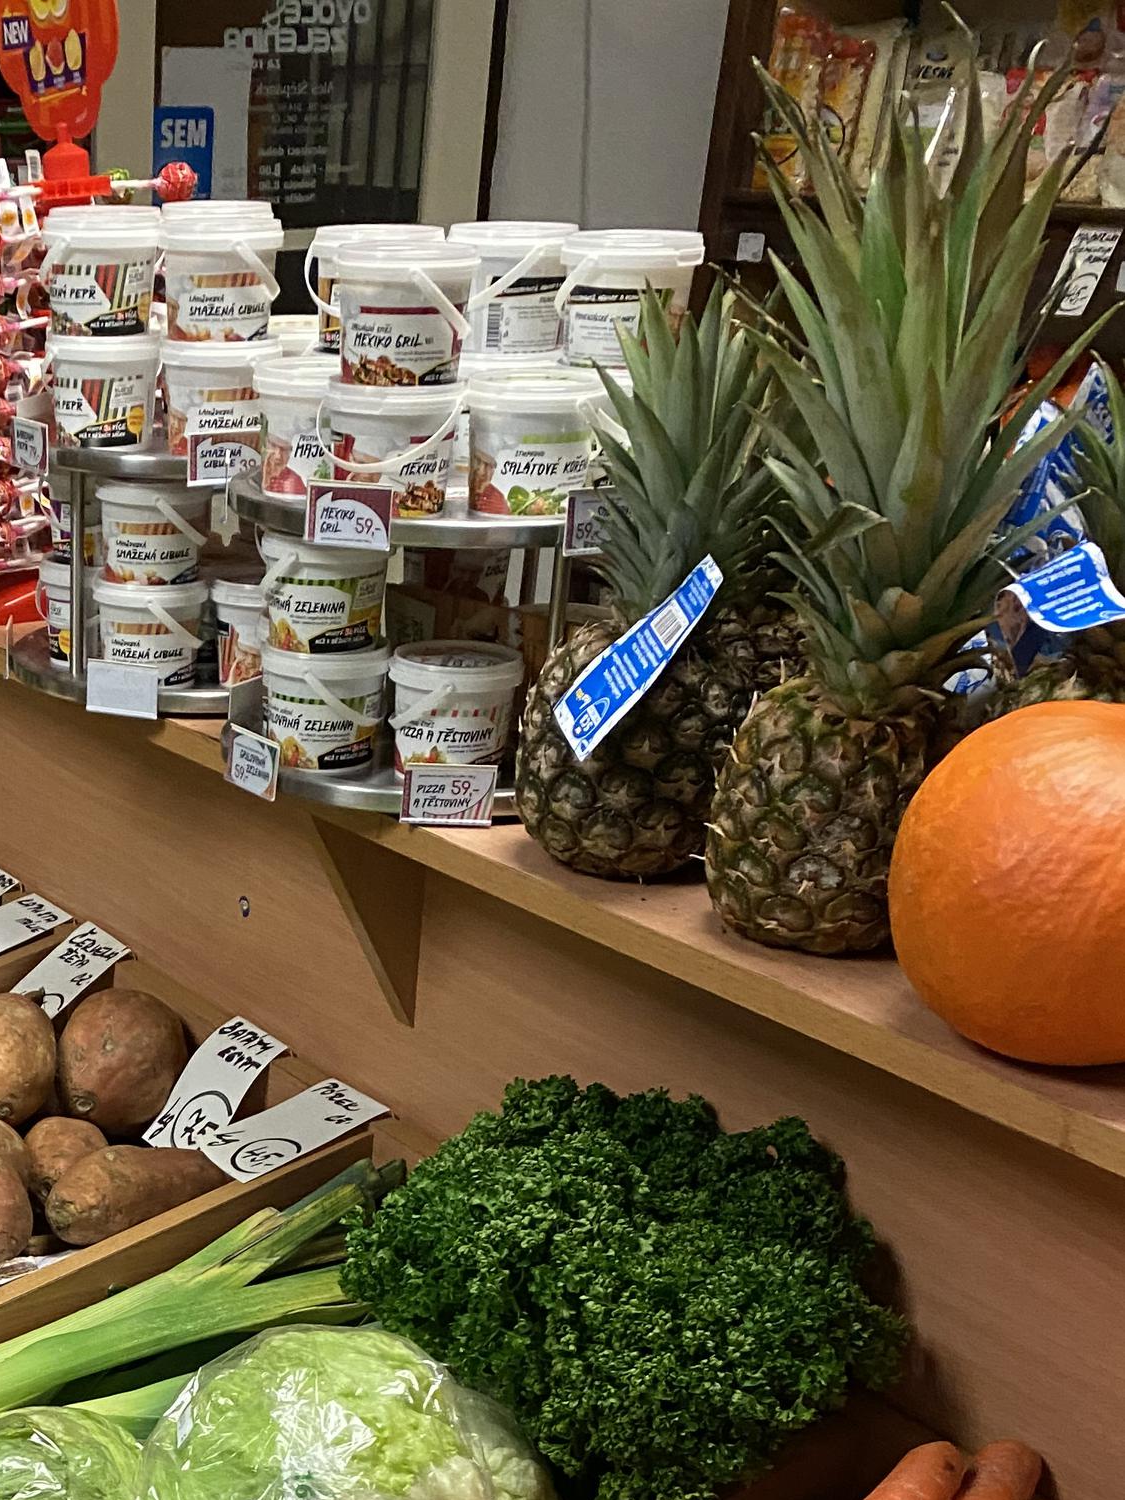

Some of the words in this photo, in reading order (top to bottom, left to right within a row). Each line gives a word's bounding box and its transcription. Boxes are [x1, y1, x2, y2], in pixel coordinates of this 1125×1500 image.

[2, 19, 29, 46] NEW
[160, 118, 207, 149] SEM
[70, 285, 96, 300] PEPŘ
[189, 302, 235, 317] SMAŽENÁ
[238, 302, 266, 315] CIBULE
[354, 332, 392, 348] MEXIKO
[395, 333, 423, 348] GRIL
[198, 416, 244, 429] SMAŽENÁ
[200, 445, 242, 459] SMAŽNÁ
[400, 460, 437, 477] MEXIKO
[501, 456, 562, 476] SALÁTOVÉ
[320, 507, 356, 520] MEXIKO
[320, 521, 342, 533] GRIL
[116, 548, 157, 560] SMAŽENÁ
[160, 547, 190, 560] CIBULE
[294, 601, 346, 613] ZELENINA
[112, 648, 150, 660] SMAŽENÁ
[154, 647, 184, 659] CIBULE
[304, 719, 354, 731] ZELENINA
[436, 727, 494, 743] TĚSTOVINY
[416, 784, 446, 794] PIZZA
[451, 780, 480, 797] 59,-
[422, 796, 472, 808] TĚSTOVINY
